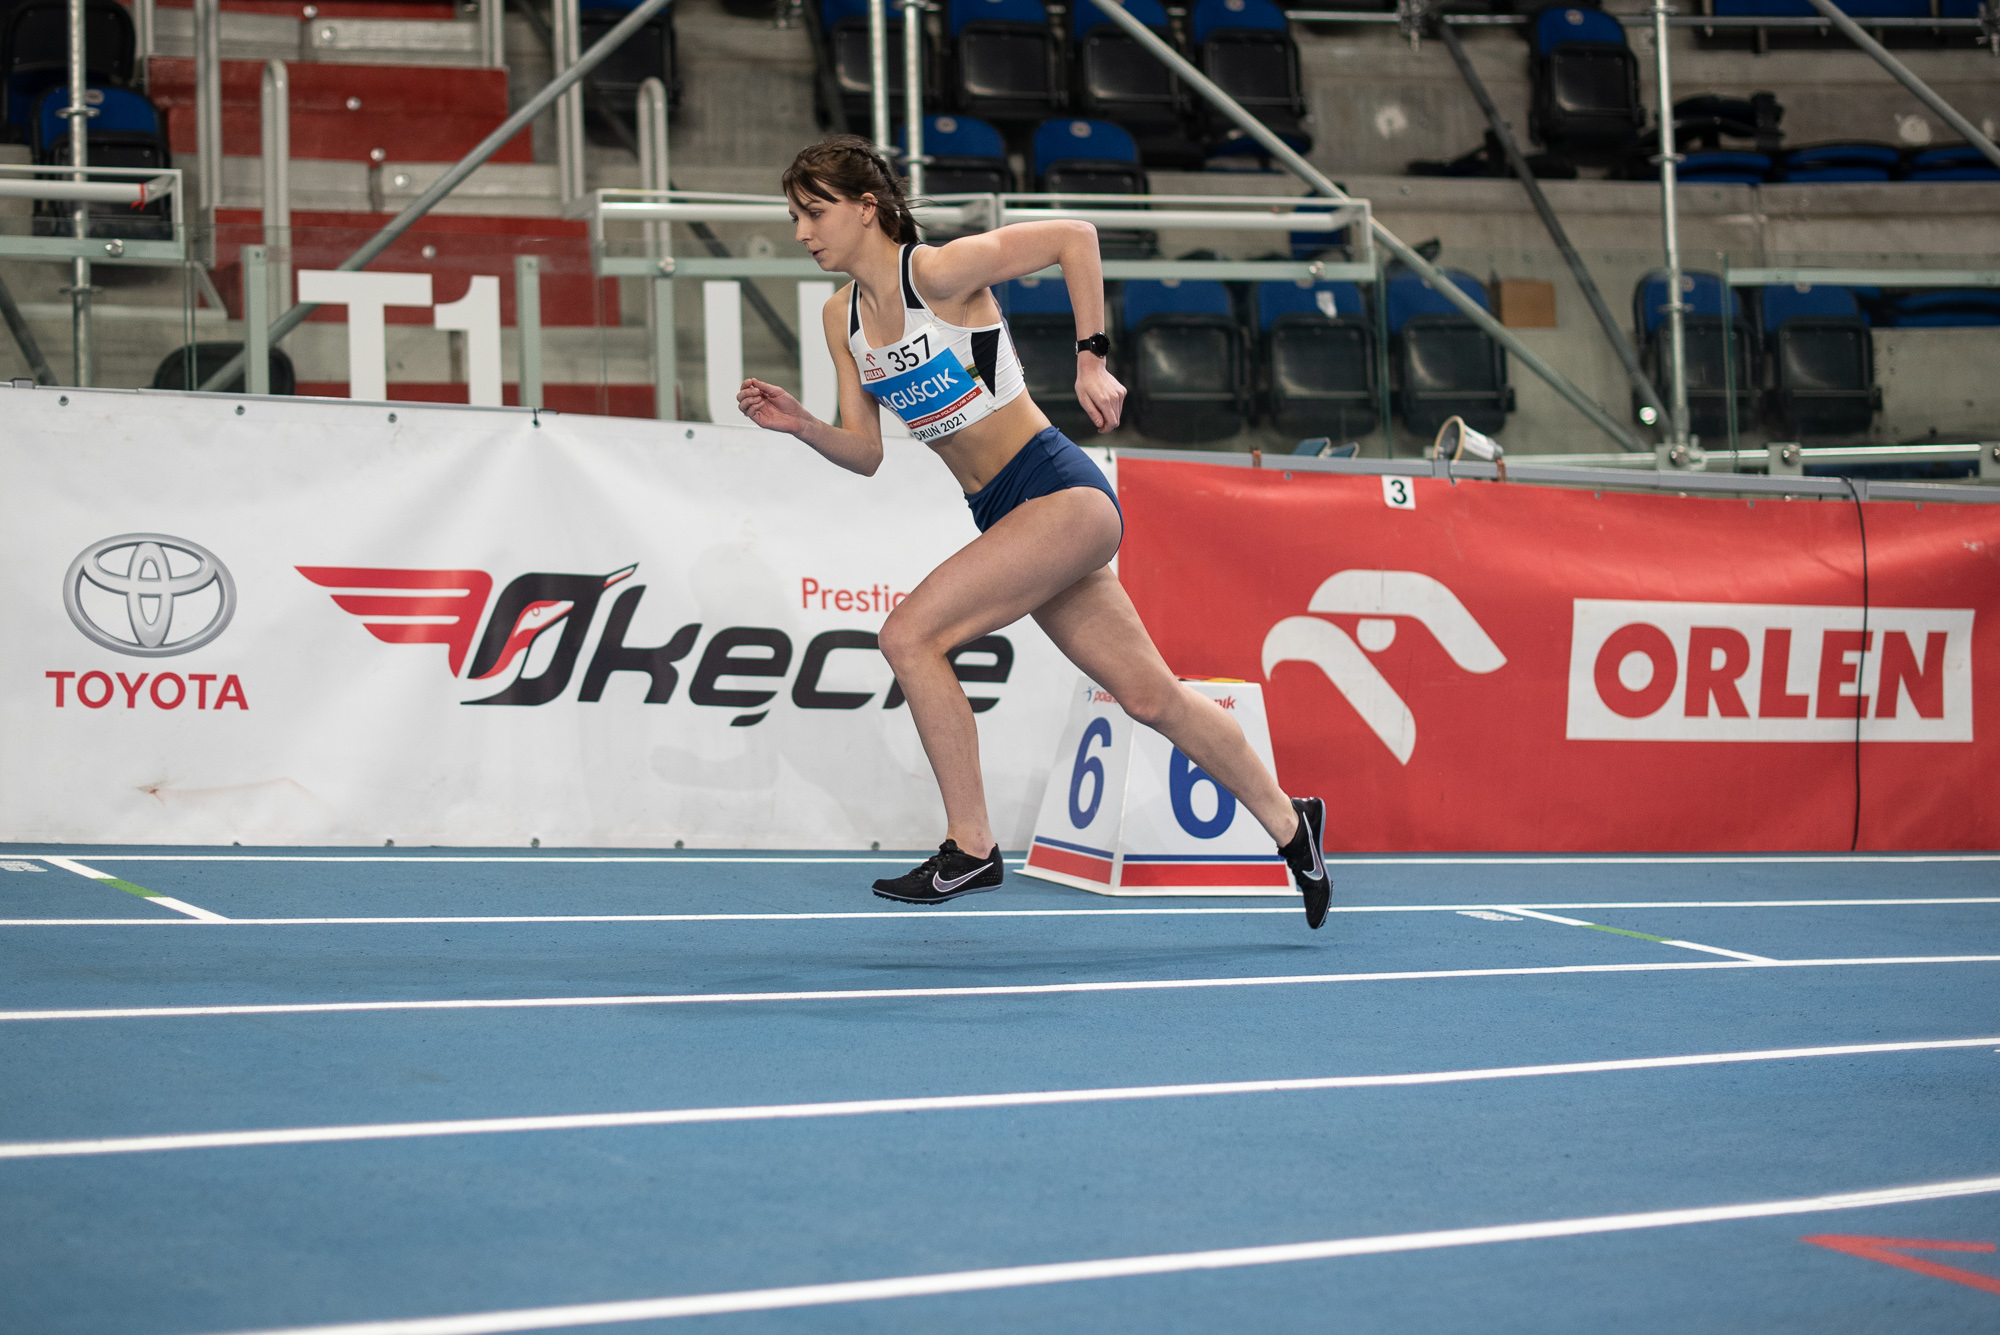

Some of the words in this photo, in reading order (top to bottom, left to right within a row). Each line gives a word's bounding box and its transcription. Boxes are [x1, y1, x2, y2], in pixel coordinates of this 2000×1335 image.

[887, 333, 931, 372] 357
[941, 412, 967, 433] 2021
[1390, 480, 1408, 504] 3
[46, 670, 249, 710] TOYOTA
[1594, 622, 1948, 719] ORLEN
[1069, 717, 1112, 830] 6
[1169, 745, 1236, 839] 6
